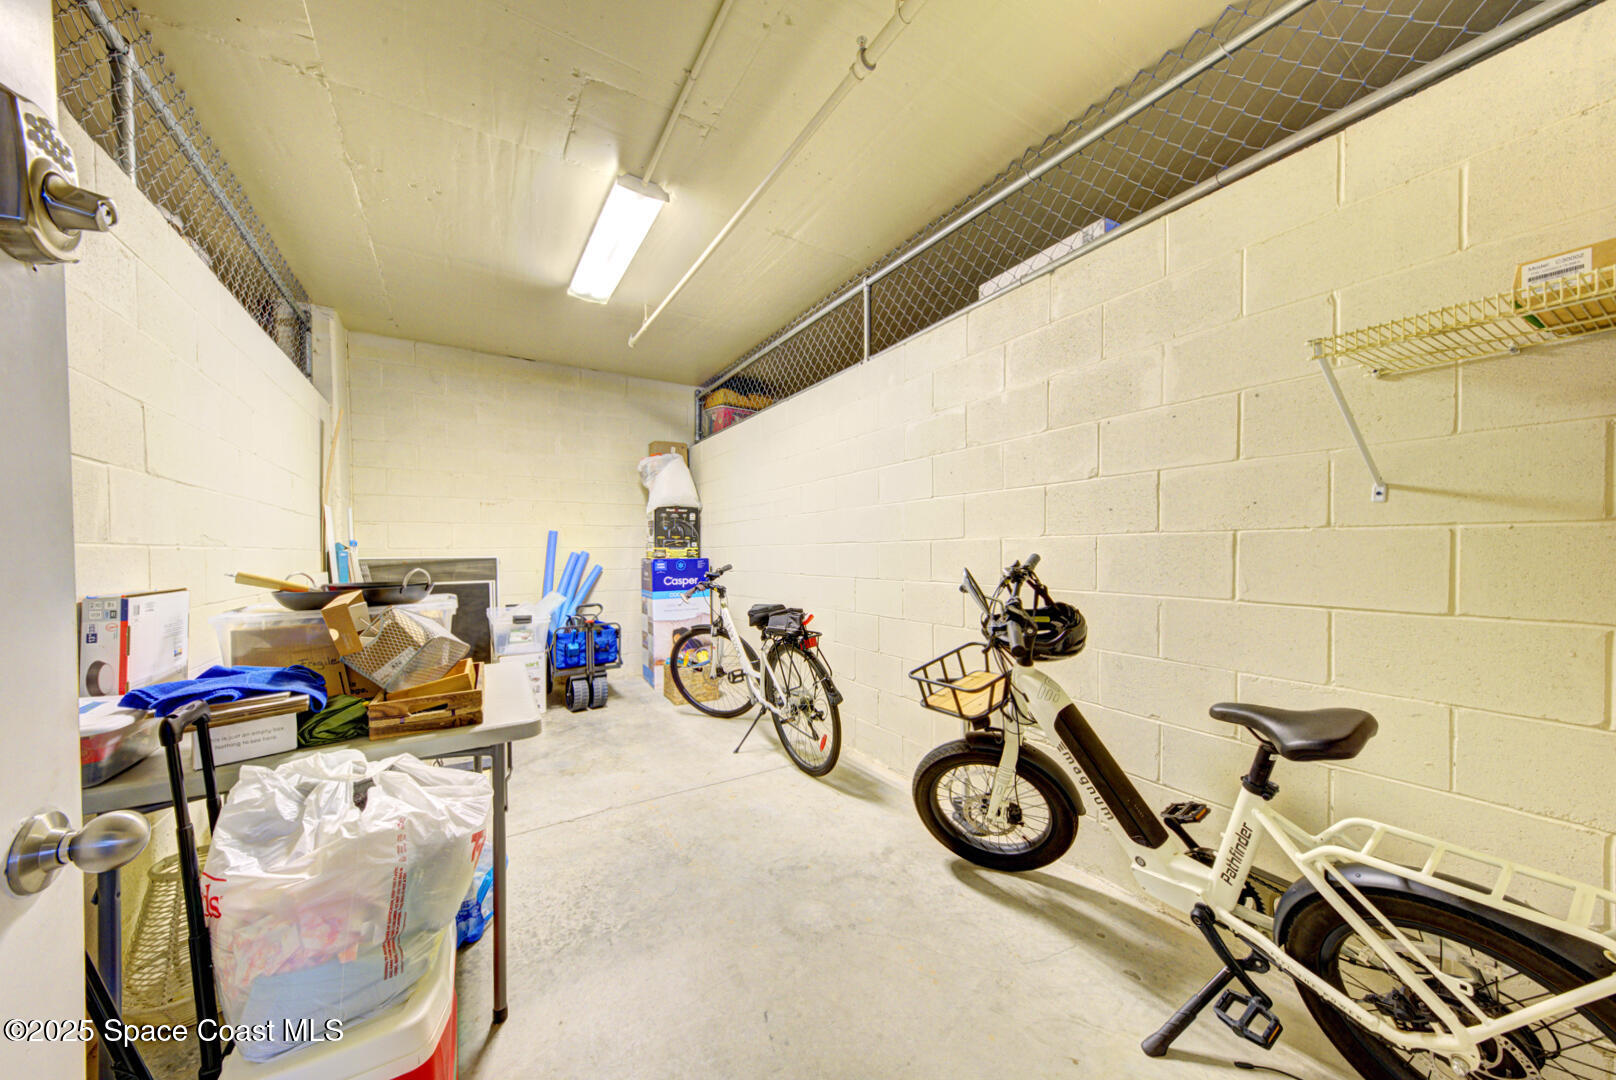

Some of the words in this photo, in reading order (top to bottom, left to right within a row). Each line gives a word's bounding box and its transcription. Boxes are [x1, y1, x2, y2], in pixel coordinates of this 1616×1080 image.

[663, 576, 699, 588] Casper
[1062, 750, 1115, 822] magnum
[1220, 822, 1254, 886] Pathfinder
